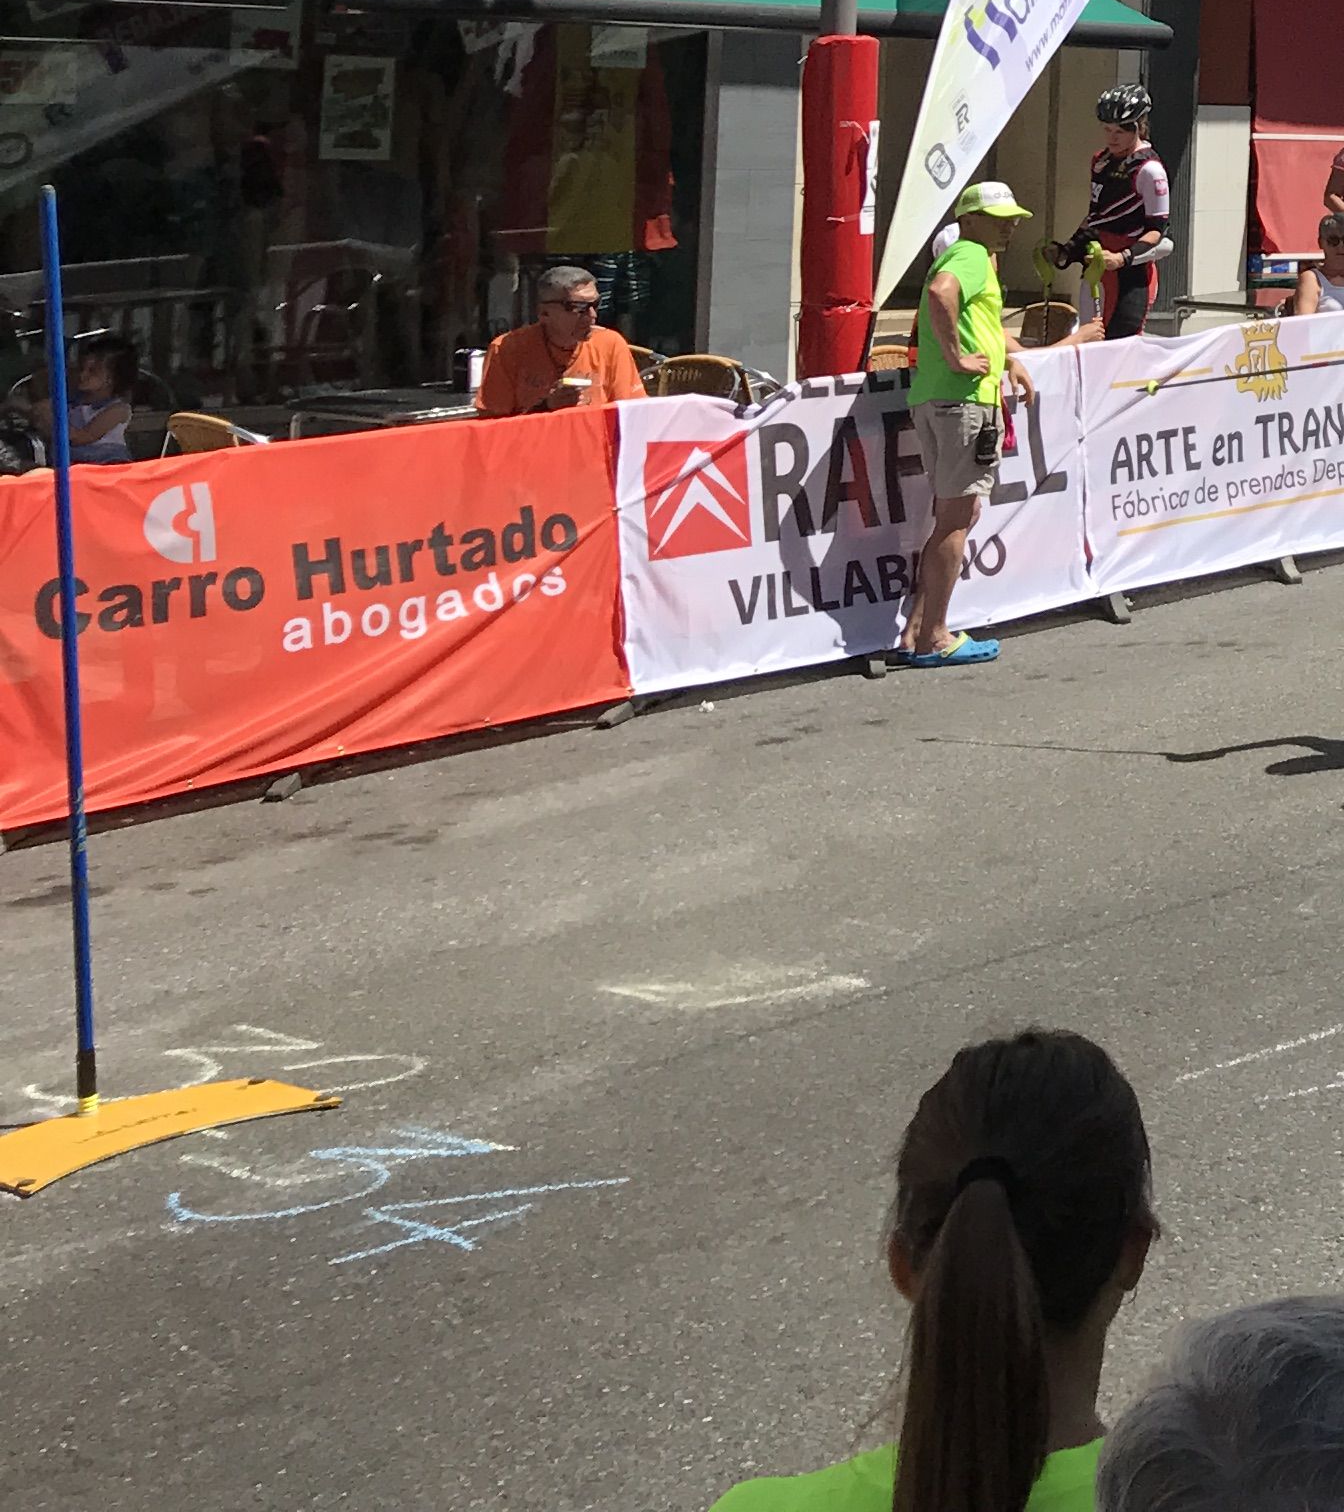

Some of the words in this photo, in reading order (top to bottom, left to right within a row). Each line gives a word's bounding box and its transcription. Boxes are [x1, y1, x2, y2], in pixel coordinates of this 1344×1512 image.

[760, 391, 1068, 543] RAFEL
[1110, 424, 1201, 486] ARTE
[1212, 431, 1245, 467] en
[1111, 485, 1189, 522] Fábrica
[1193, 481, 1219, 506] de
[1226, 469, 1308, 511] prendas
[34, 564, 266, 640] Carro
[291, 505, 579, 600] Hurtado
[282, 564, 568, 653] abogados
